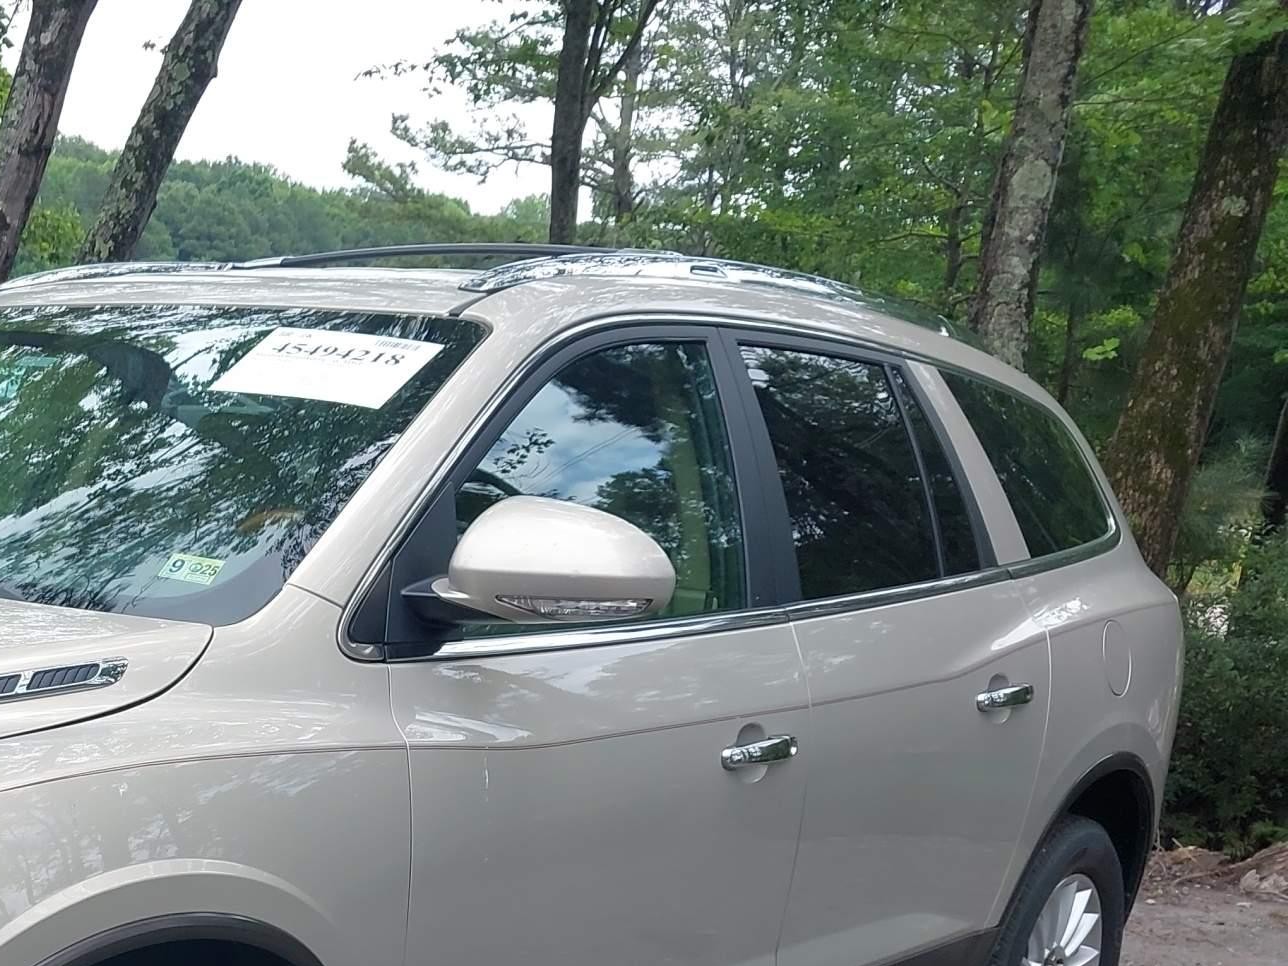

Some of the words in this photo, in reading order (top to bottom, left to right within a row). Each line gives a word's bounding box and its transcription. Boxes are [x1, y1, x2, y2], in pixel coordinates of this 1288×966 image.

[271, 342, 406, 366] 45494218
[169, 559, 185, 573] 9
[199, 564, 220, 577] 25
